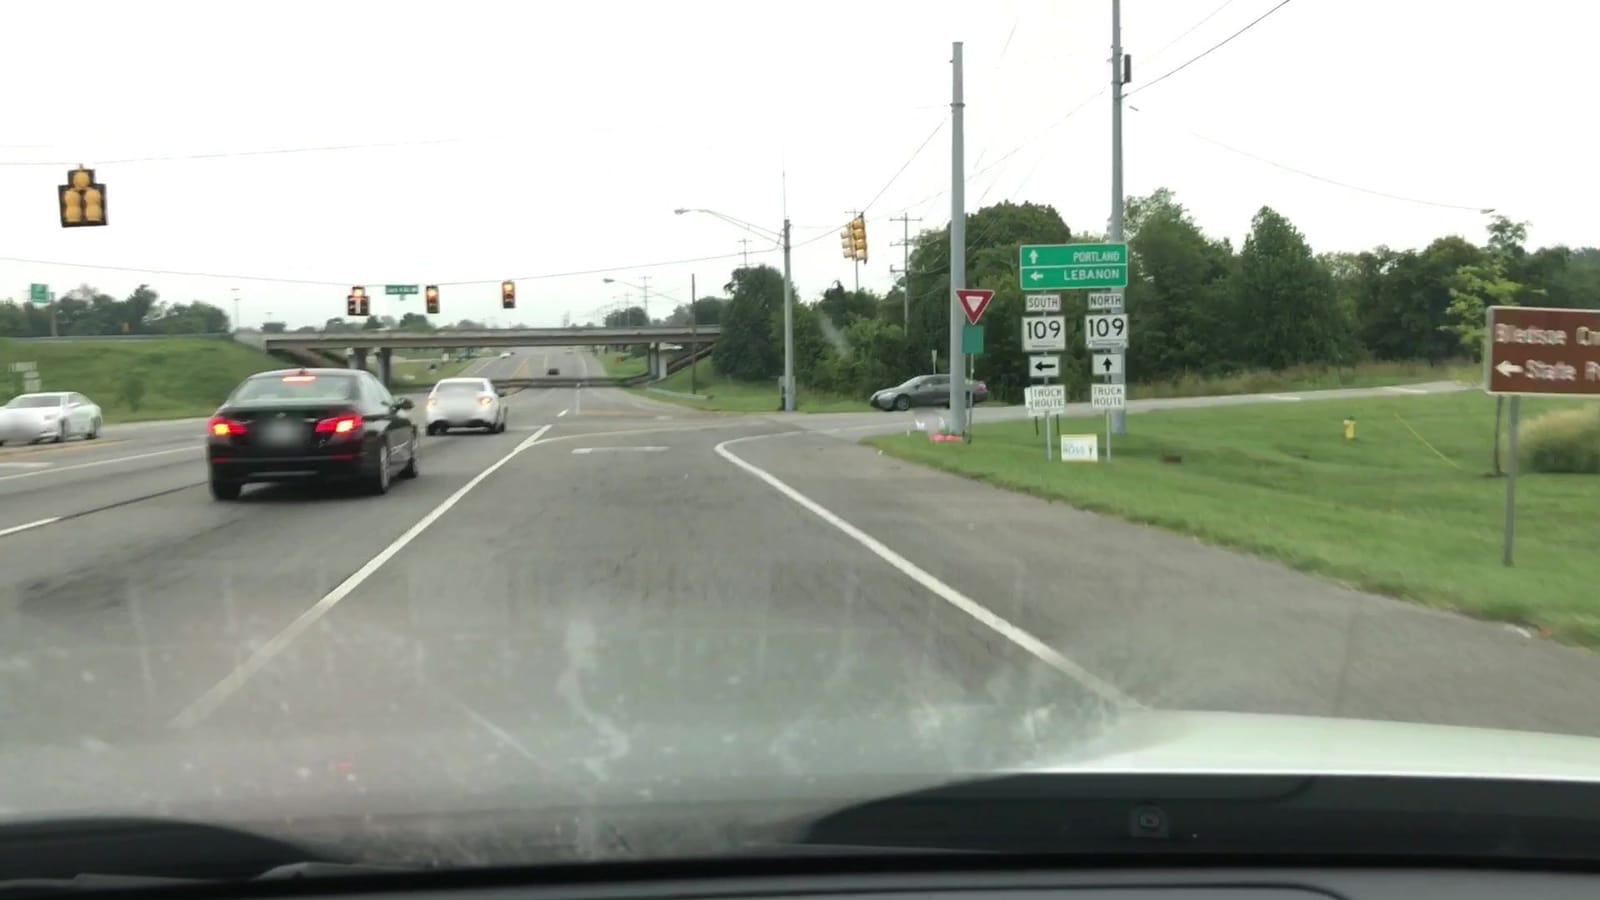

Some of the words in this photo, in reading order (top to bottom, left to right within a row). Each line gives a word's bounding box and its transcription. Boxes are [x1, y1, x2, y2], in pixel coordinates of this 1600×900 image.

[1073, 251, 1120, 262] PORTLAND
[1063, 269, 1119, 281] LEBANON
[1028, 297, 1058, 308] SOUTH
[1090, 295, 1120, 306] NORTH
[1026, 320, 1061, 340] 109
[1088, 318, 1124, 337] 109
[1525, 359, 1577, 381] State
[1033, 388, 1062, 398] TRUCK
[1093, 386, 1122, 396] TRUCK
[1033, 398, 1063, 409] ROUTE
[1093, 396, 1121, 407] ROUTE
